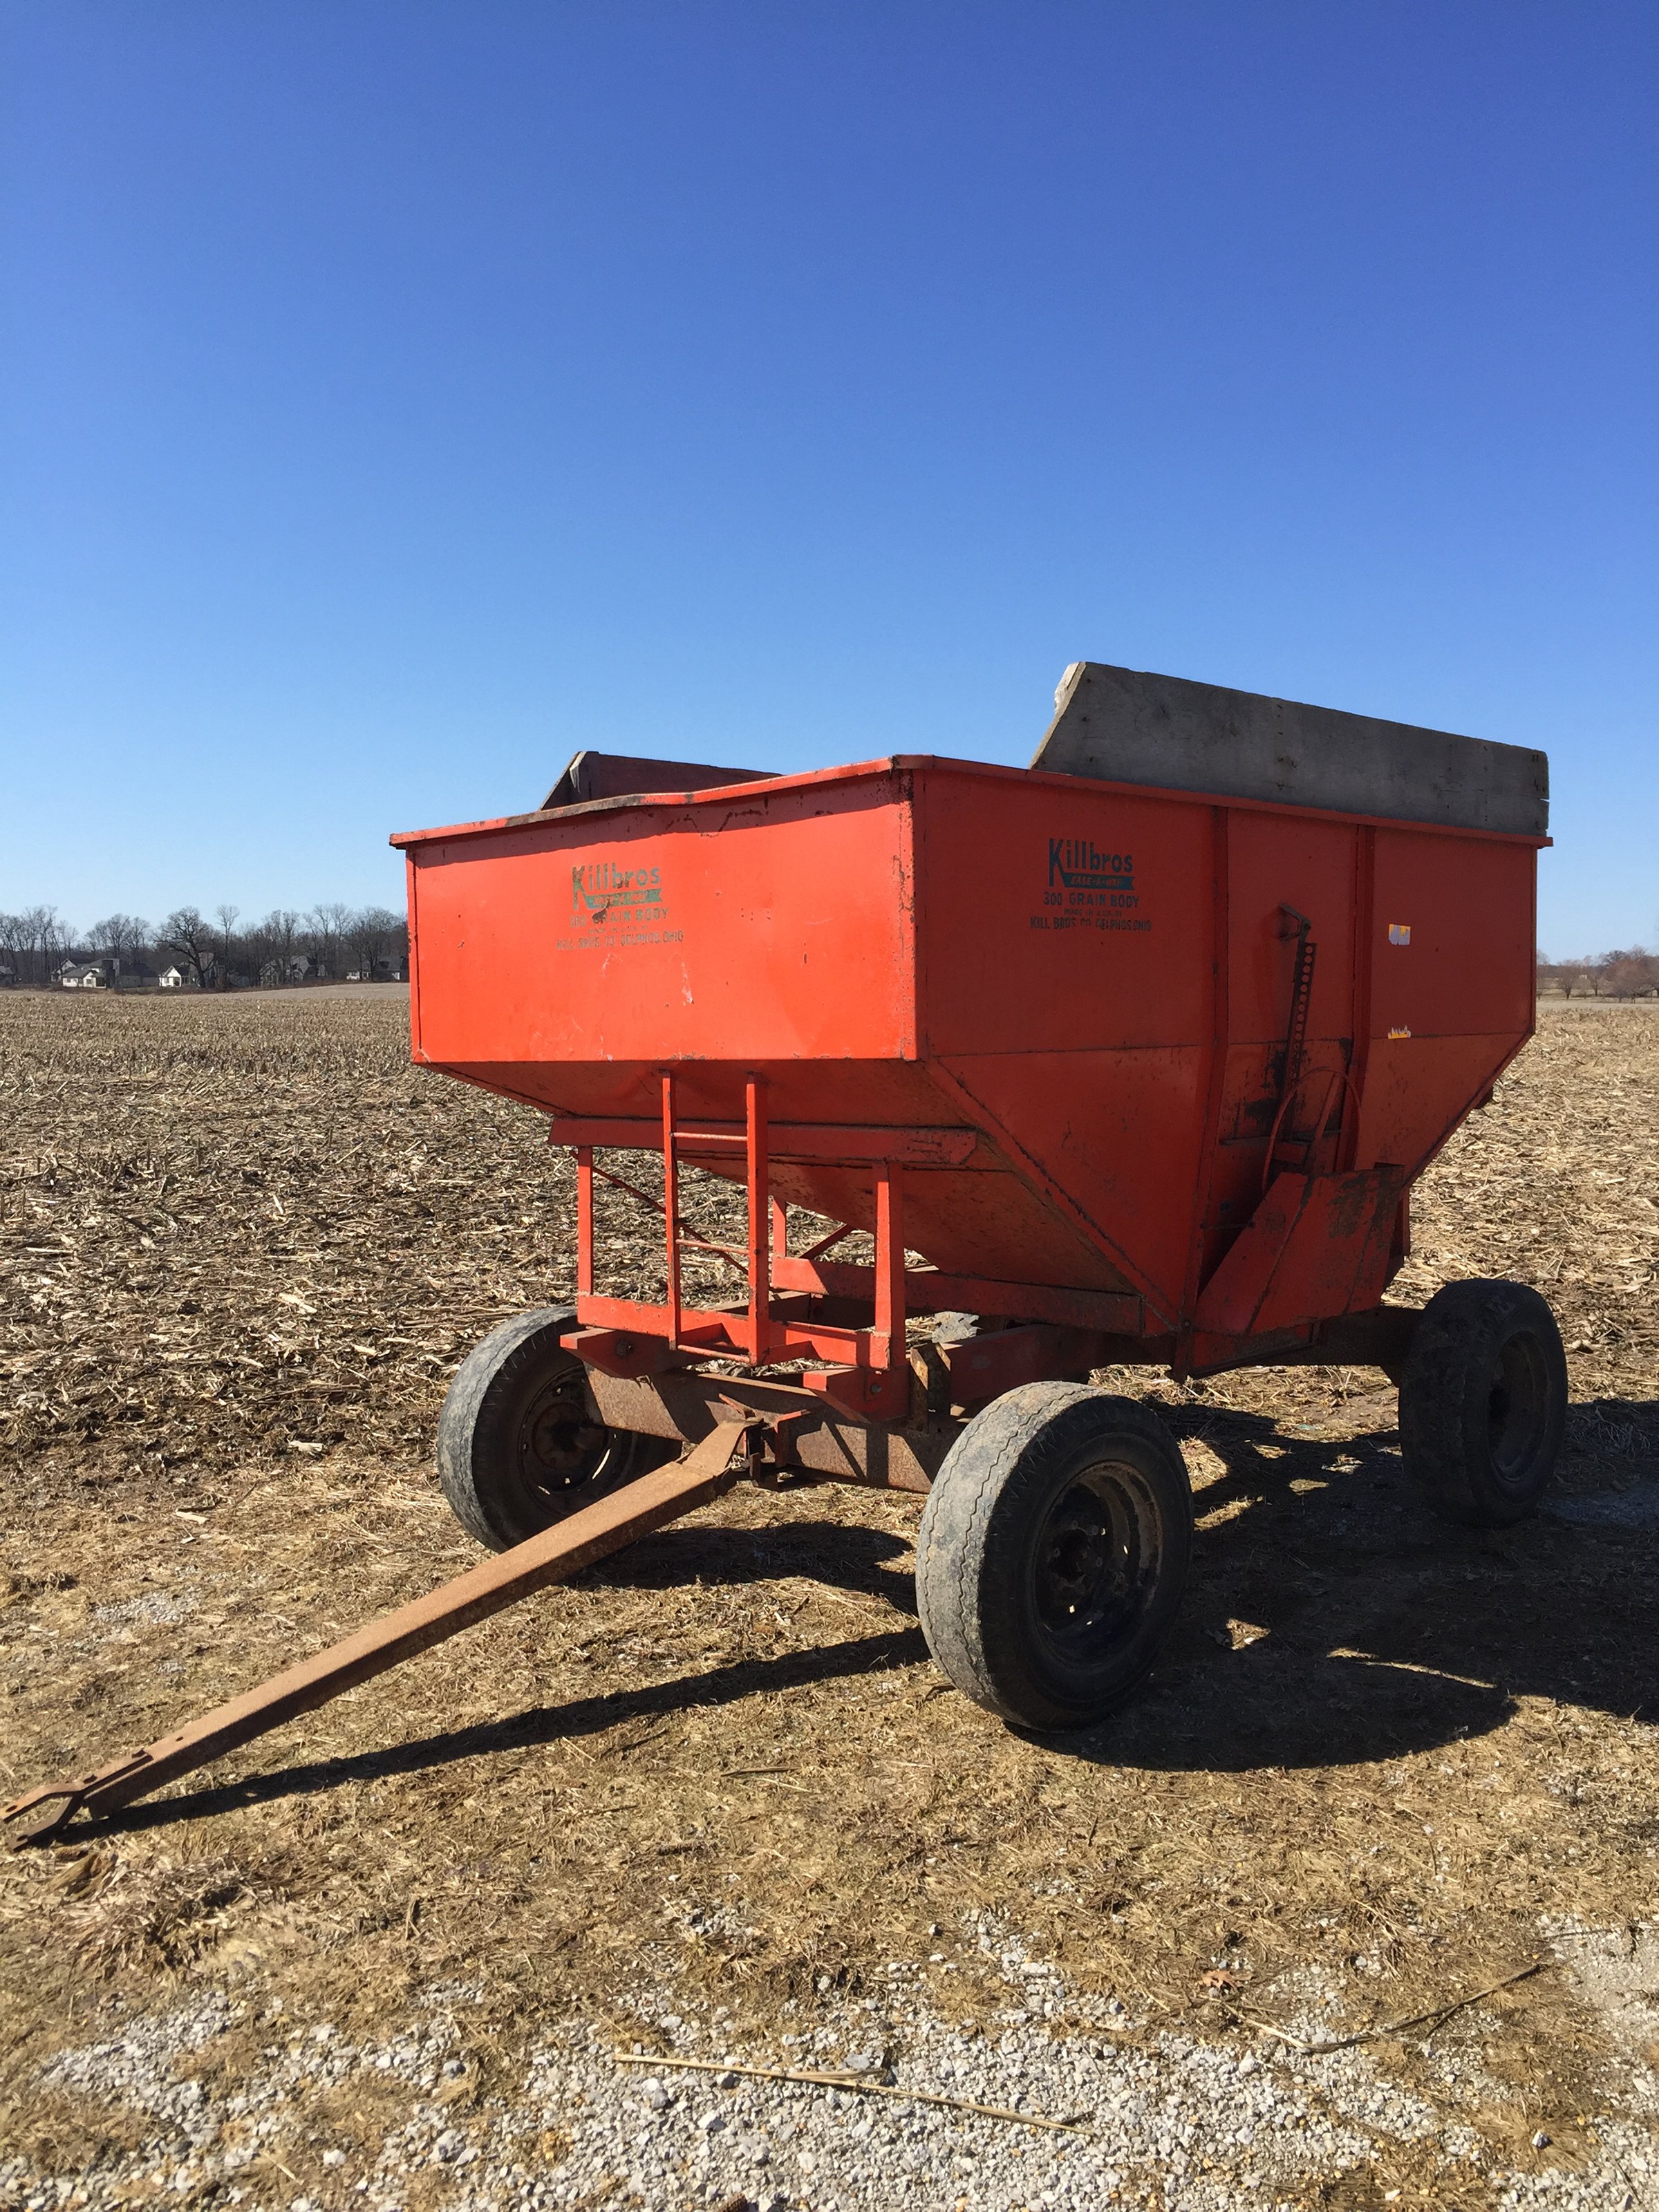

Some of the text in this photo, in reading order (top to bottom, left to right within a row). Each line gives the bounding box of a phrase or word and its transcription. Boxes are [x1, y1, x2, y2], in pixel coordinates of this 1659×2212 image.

[1049, 838, 1133, 887] Killbros
[572, 863, 661, 911] Killbros
[1044, 892, 1140, 908] 300 GRAIN BODY
[635, 907, 669, 921] BODY
[1030, 917, 1050, 930] KILL
